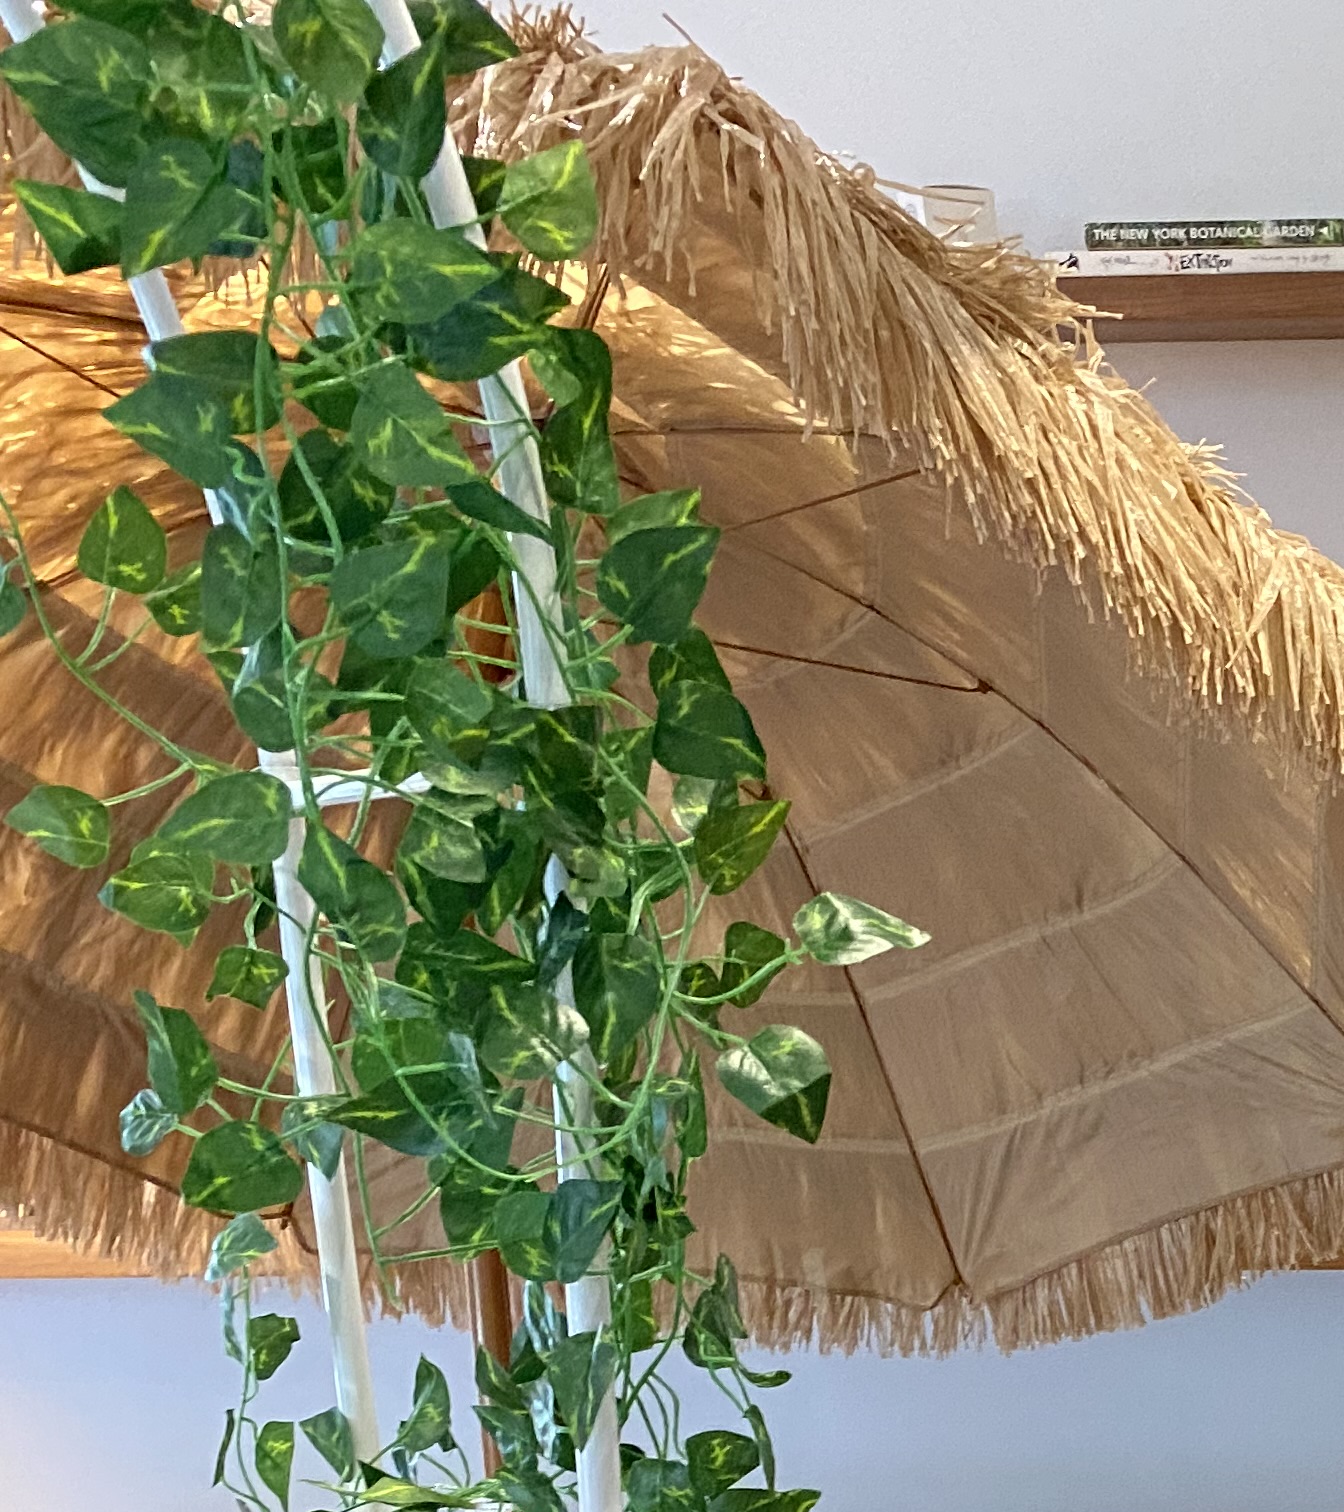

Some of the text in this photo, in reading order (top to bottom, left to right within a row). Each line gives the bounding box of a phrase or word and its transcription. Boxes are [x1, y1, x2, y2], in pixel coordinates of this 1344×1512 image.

[1093, 224, 1316, 241] THE NEW YORK BOTANICAL GARDEN
